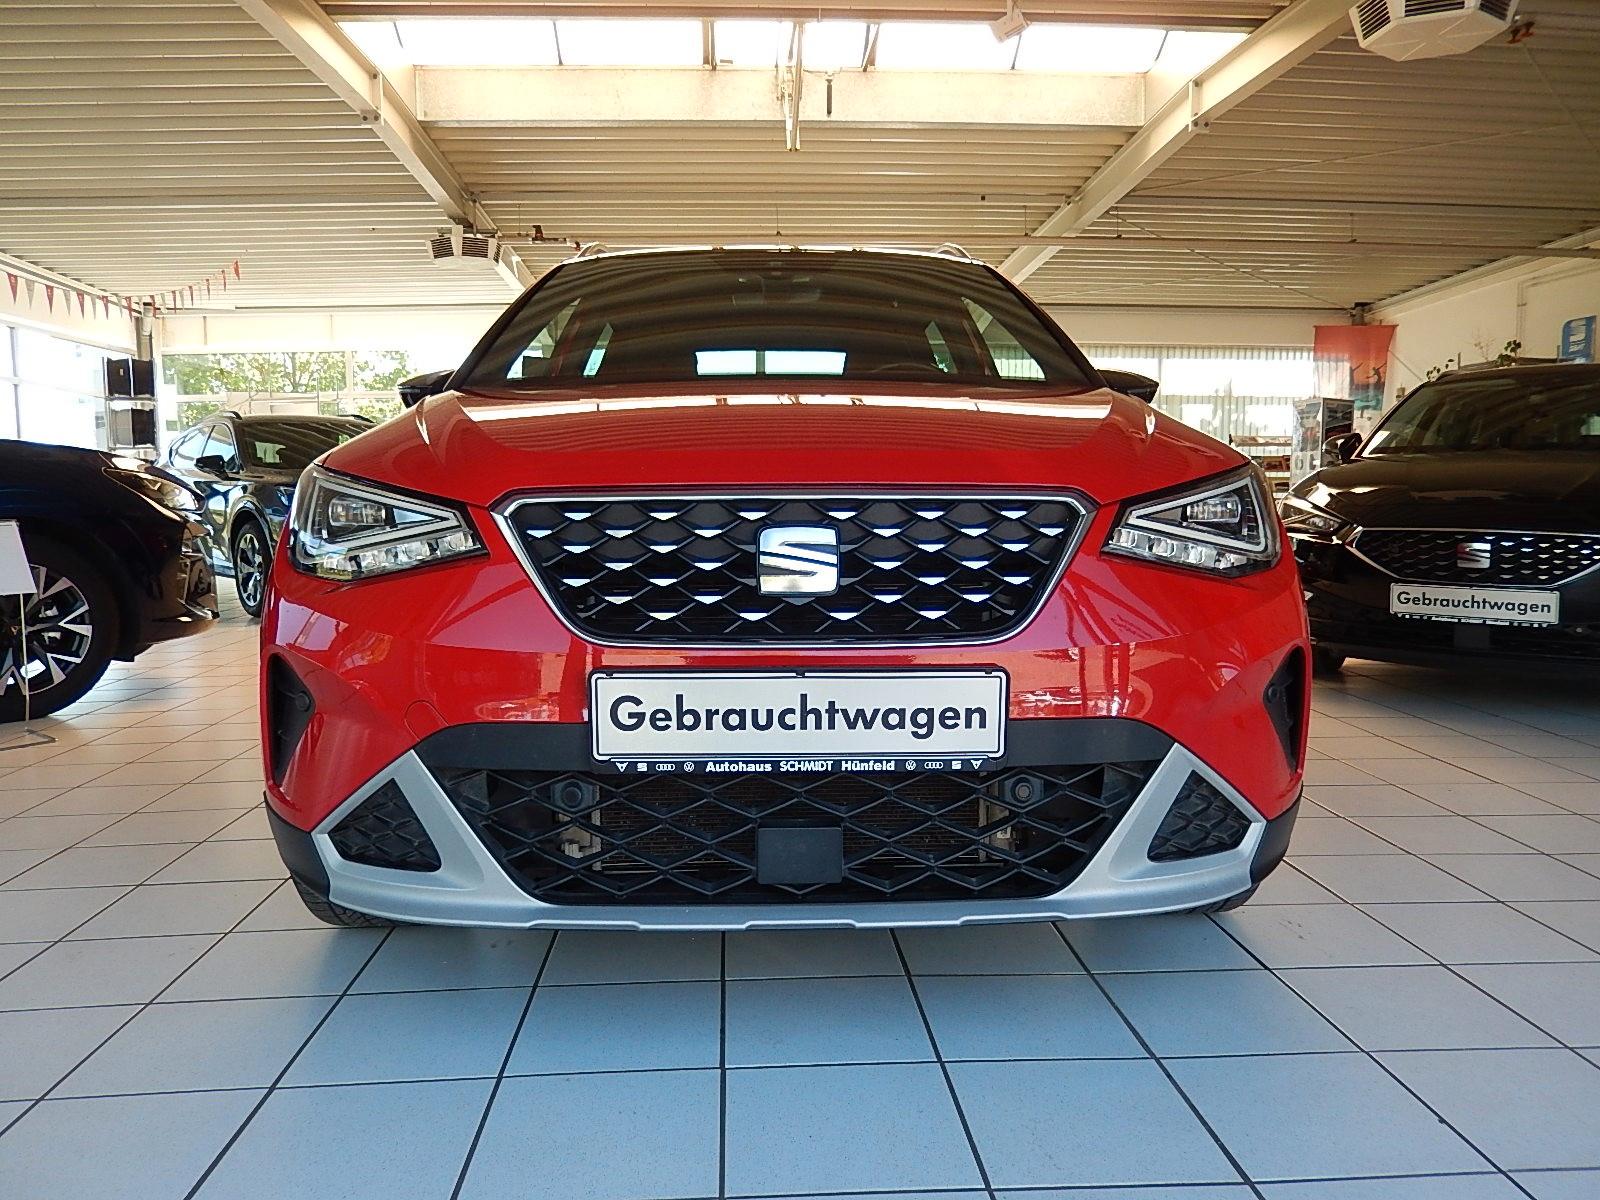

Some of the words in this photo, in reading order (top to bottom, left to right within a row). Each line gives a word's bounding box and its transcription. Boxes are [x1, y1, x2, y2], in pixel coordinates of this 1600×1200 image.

[1396, 591, 1552, 616] Gebrauchtwagen
[609, 694, 987, 739] Gebrauchtwagen
[705, 761, 773, 772] Autohaus
[779, 760, 834, 771] SCHMIDT
[841, 760, 896, 771] Hünfeld
